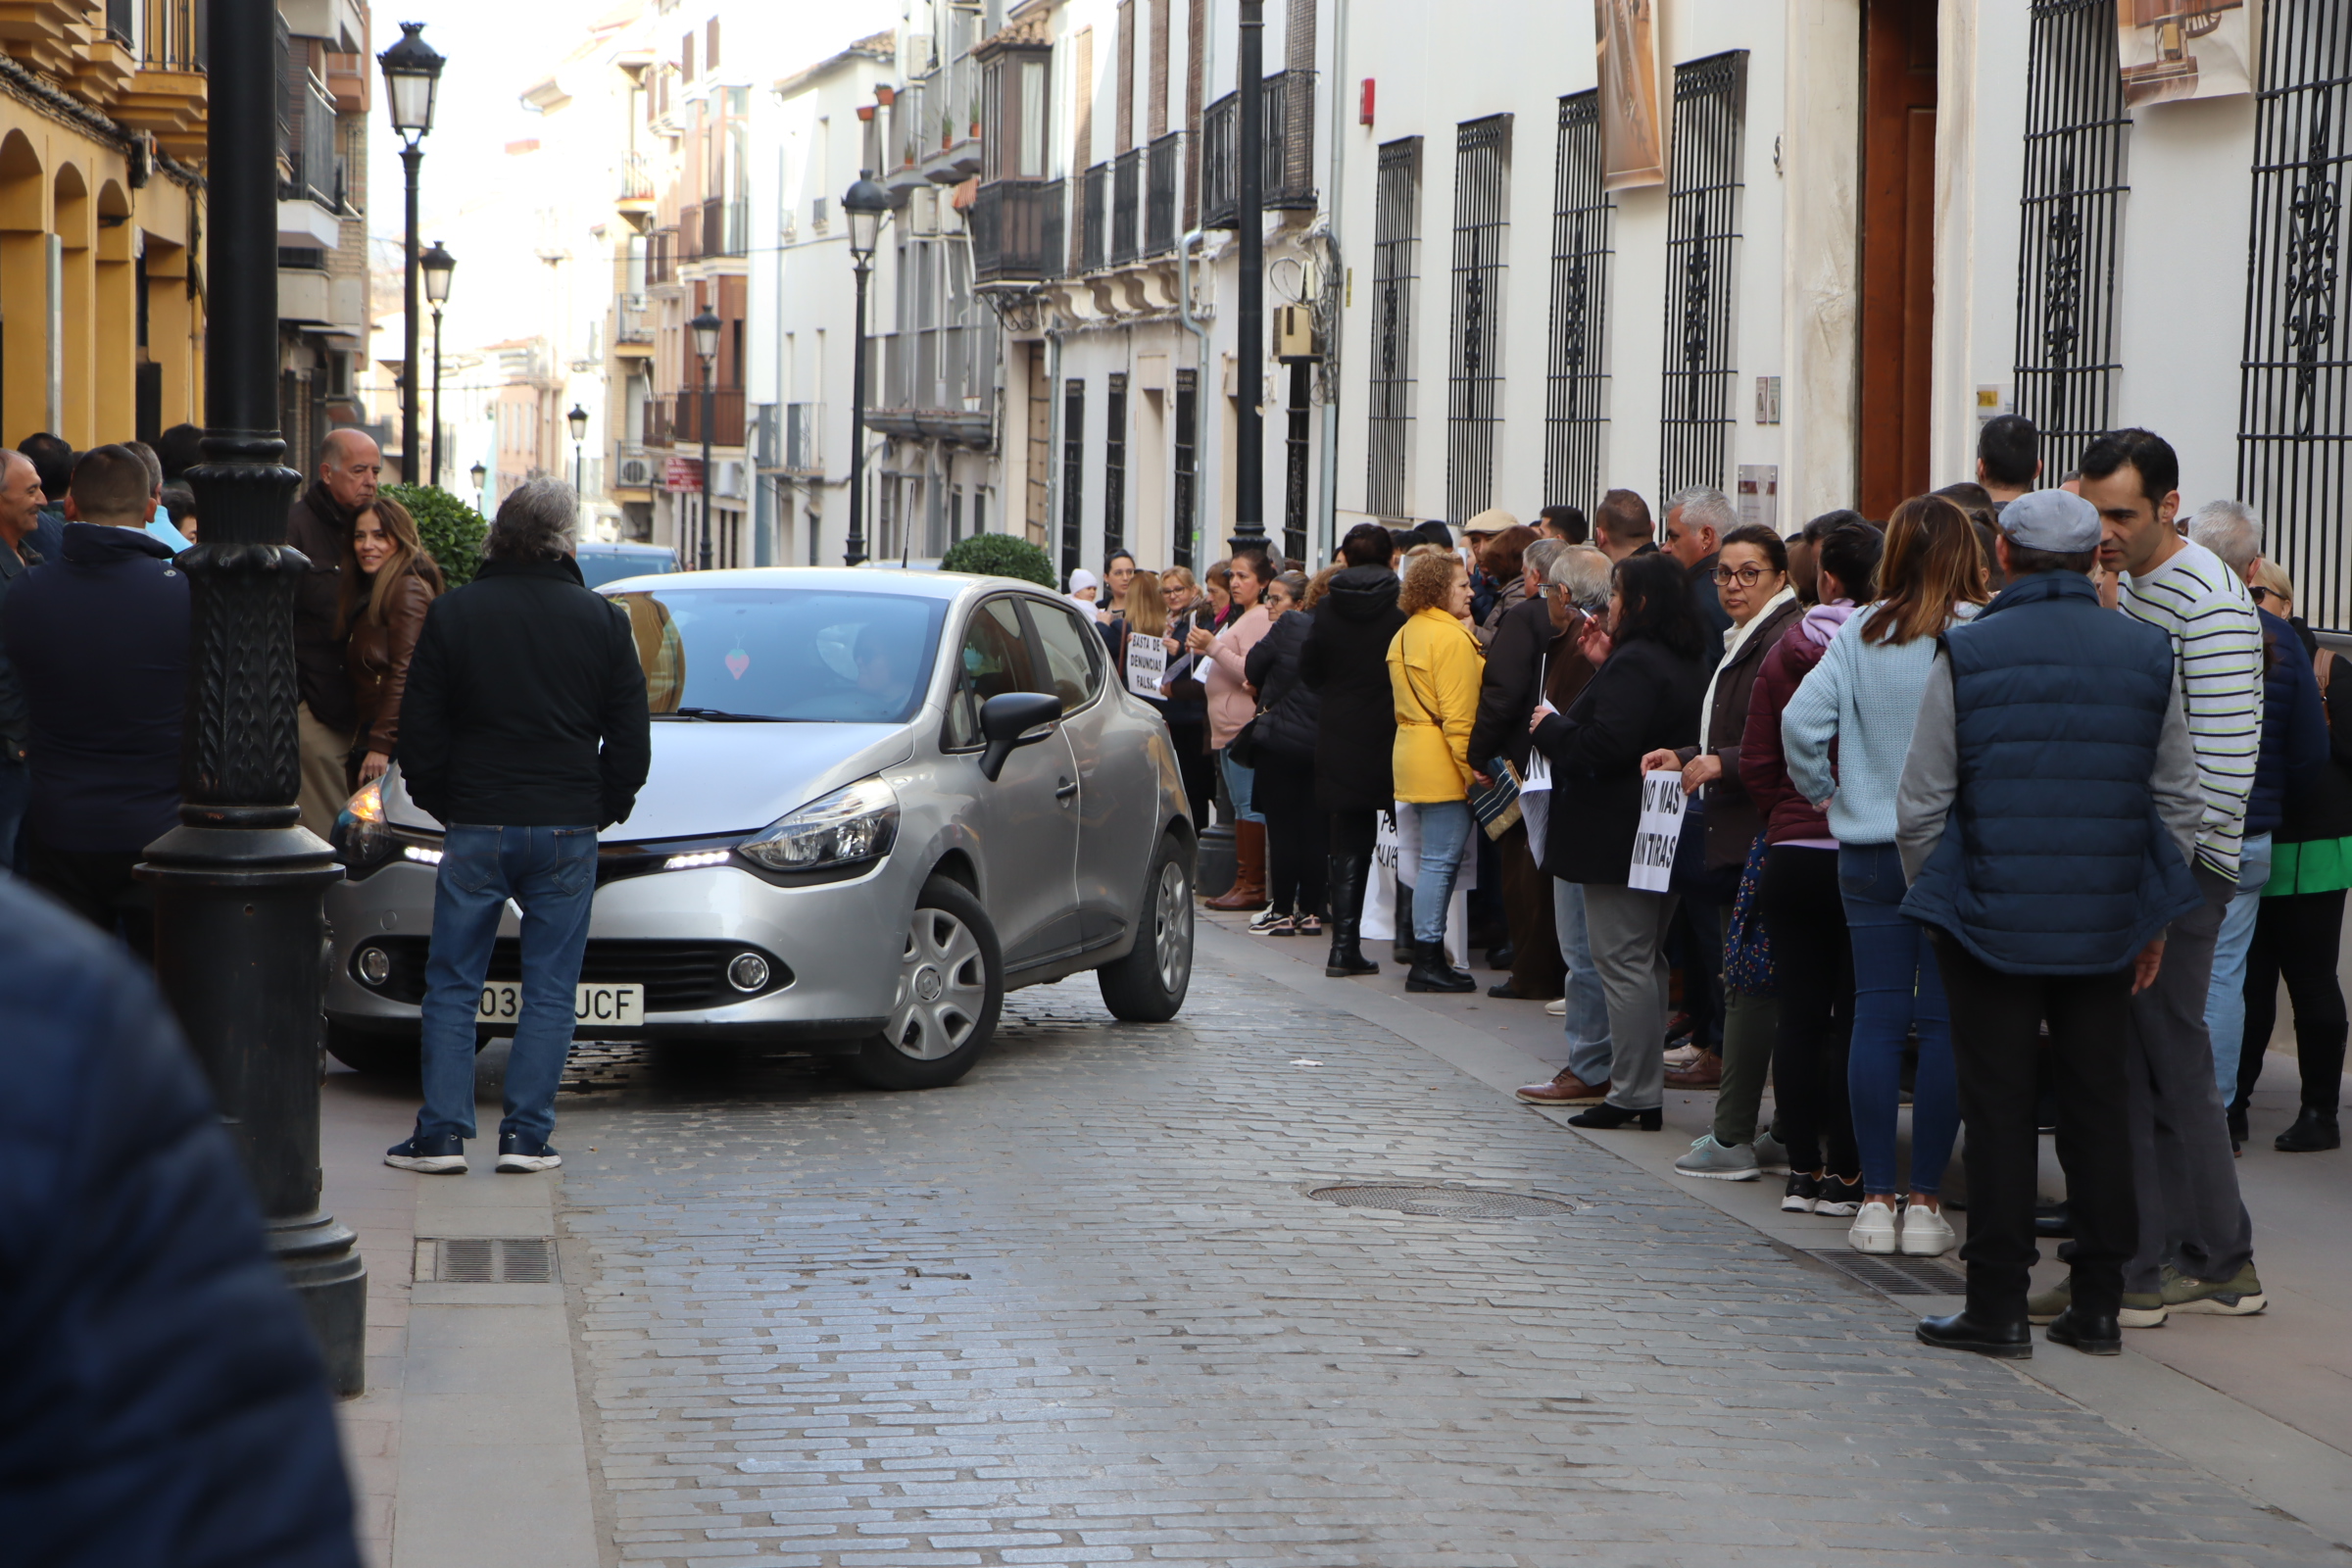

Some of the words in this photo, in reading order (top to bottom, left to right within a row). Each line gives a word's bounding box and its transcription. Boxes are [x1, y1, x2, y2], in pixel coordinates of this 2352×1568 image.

[1132, 634, 1151, 651] BASTA
[1152, 638, 1160, 652] DE
[1130, 654, 1162, 672] DENUNCIAS
[1642, 779, 1656, 812] NO
[1658, 780, 1681, 815] MAS
[1633, 831, 1677, 869] MNTIRAS
[574, 989, 634, 1020] JCF
